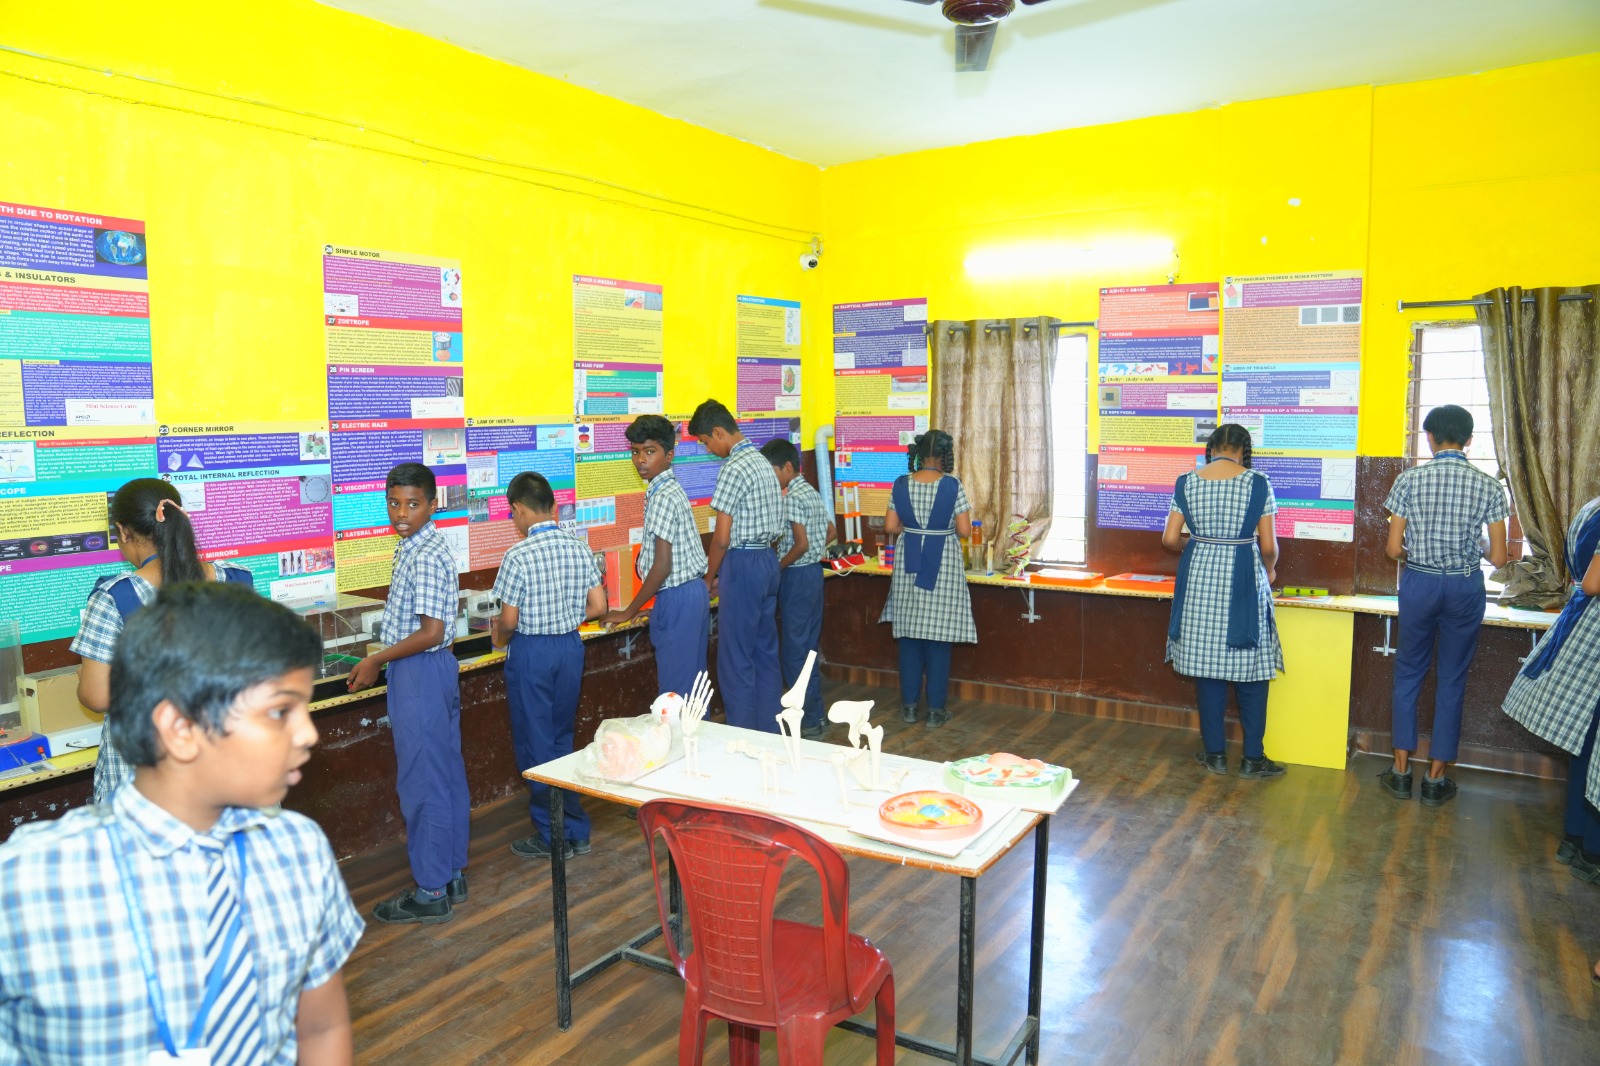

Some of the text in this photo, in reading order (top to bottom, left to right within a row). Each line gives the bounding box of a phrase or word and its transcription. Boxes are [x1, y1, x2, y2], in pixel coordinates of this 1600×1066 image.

[16, 208, 37, 217] DUE
[40, 210, 53, 219] TO
[56, 212, 102, 225] ROTATION
[15, 272, 76, 283] INSULATORS
[238, 470, 280, 478] REFLECTION
[206, 550, 239, 558] MIRRORS
